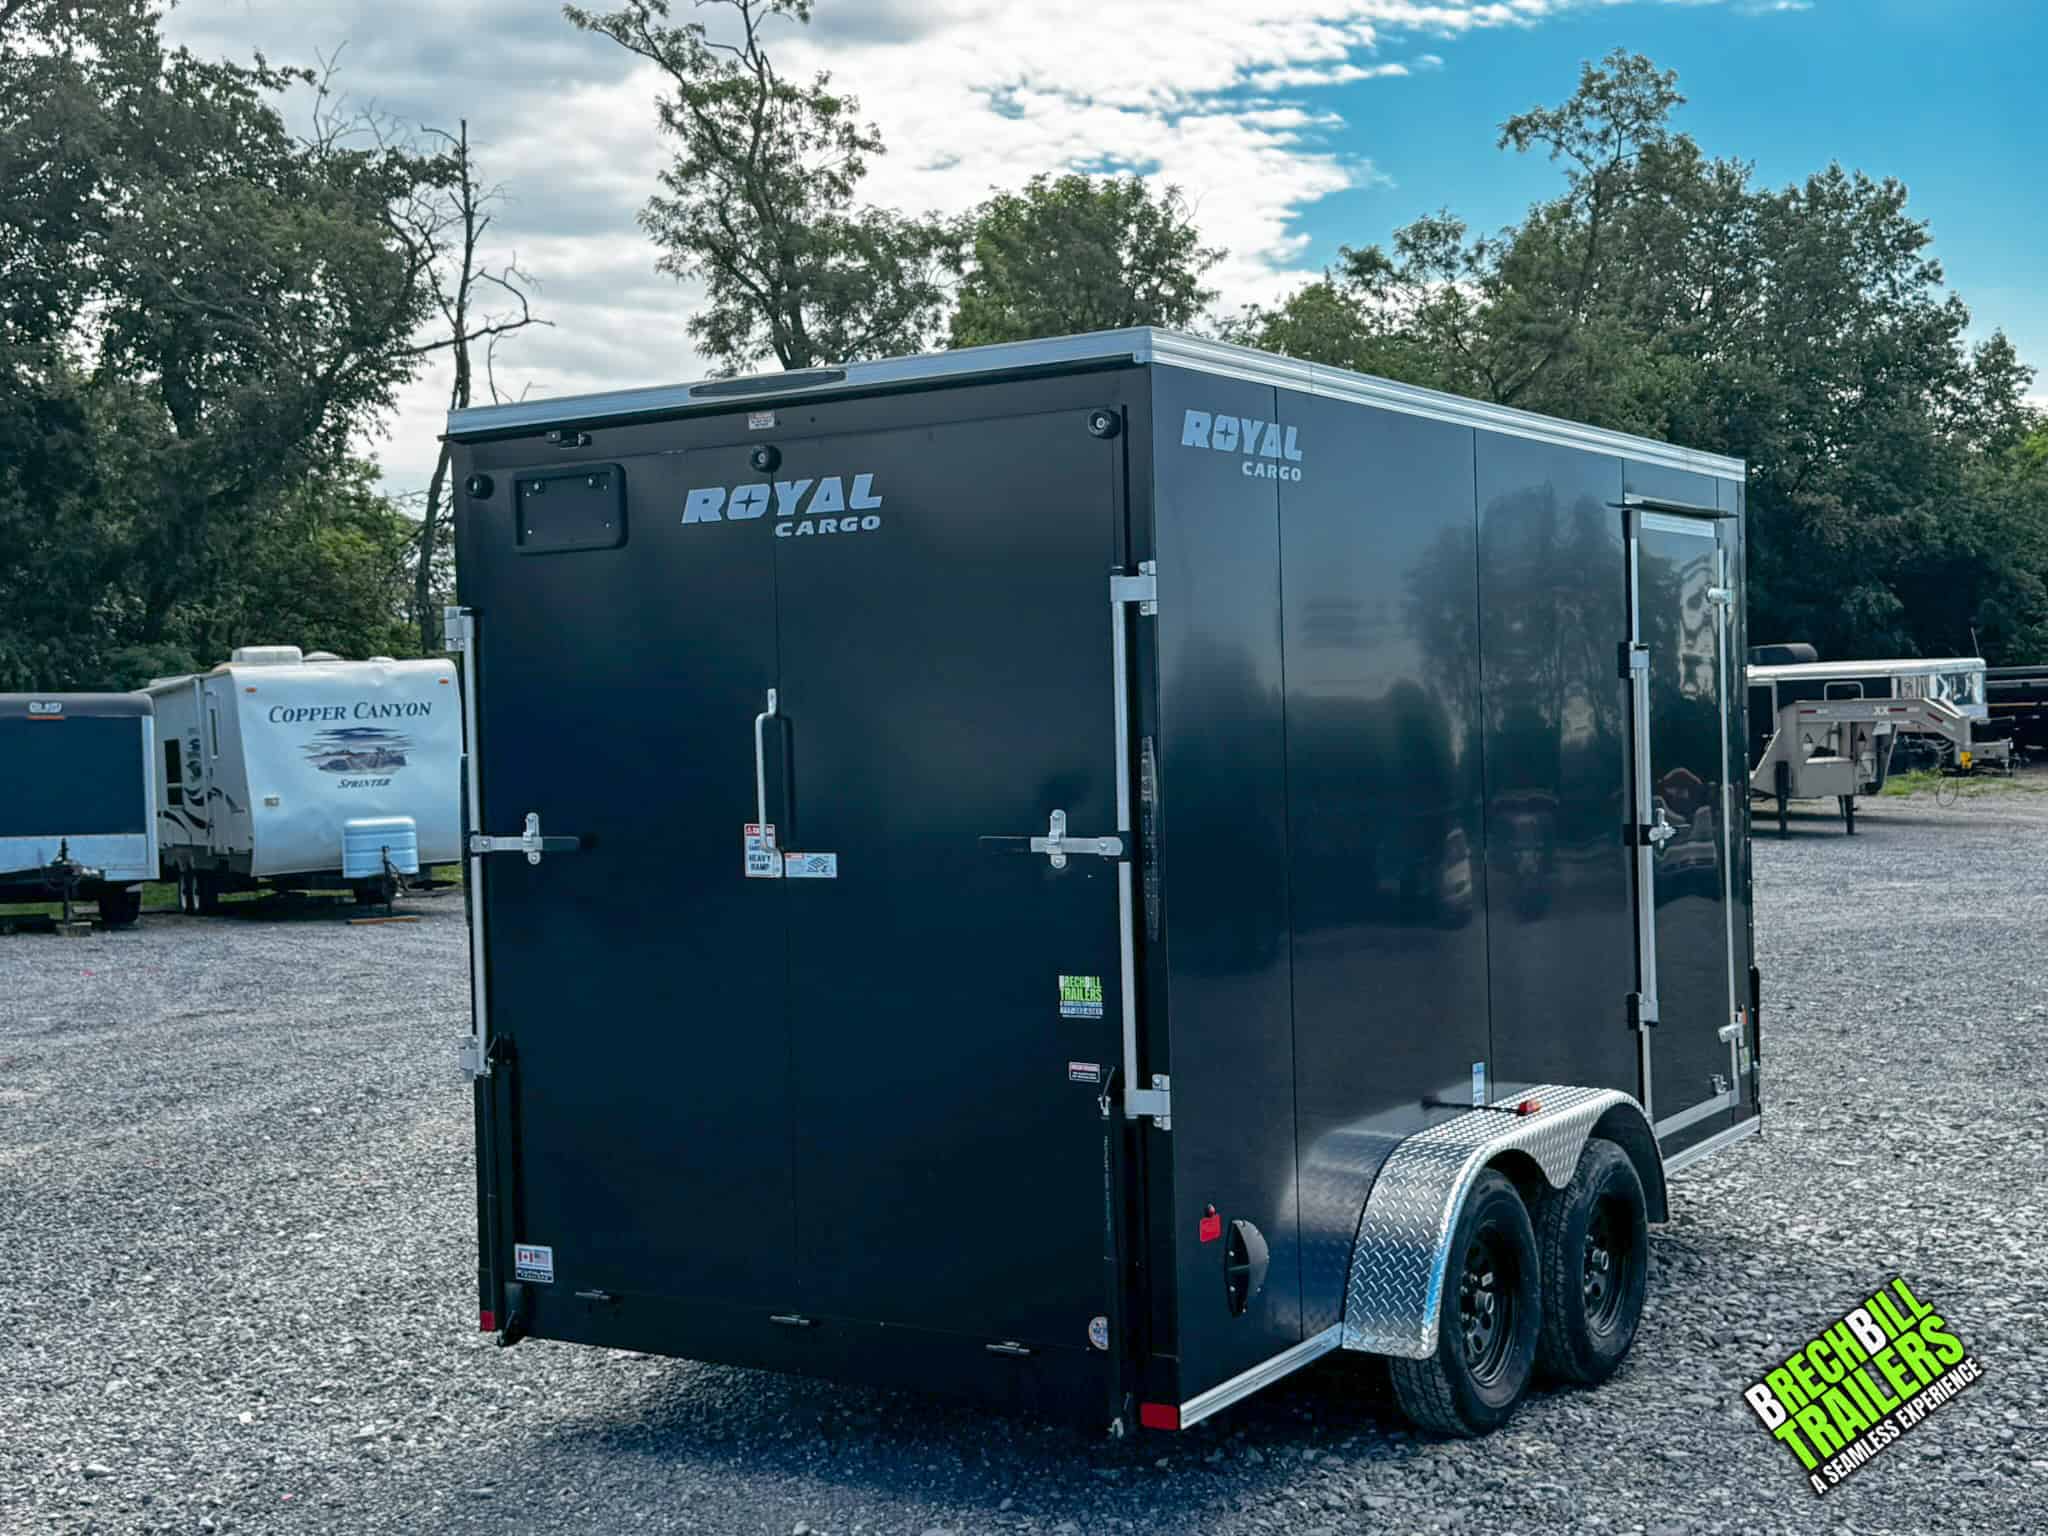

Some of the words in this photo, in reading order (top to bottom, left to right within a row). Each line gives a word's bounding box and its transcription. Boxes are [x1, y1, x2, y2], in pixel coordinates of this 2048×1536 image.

[1181, 409, 1303, 461] ROYAL
[1241, 461, 1302, 481] CARGO
[681, 473, 883, 524] ROYAL
[774, 515, 881, 537] CARGO
